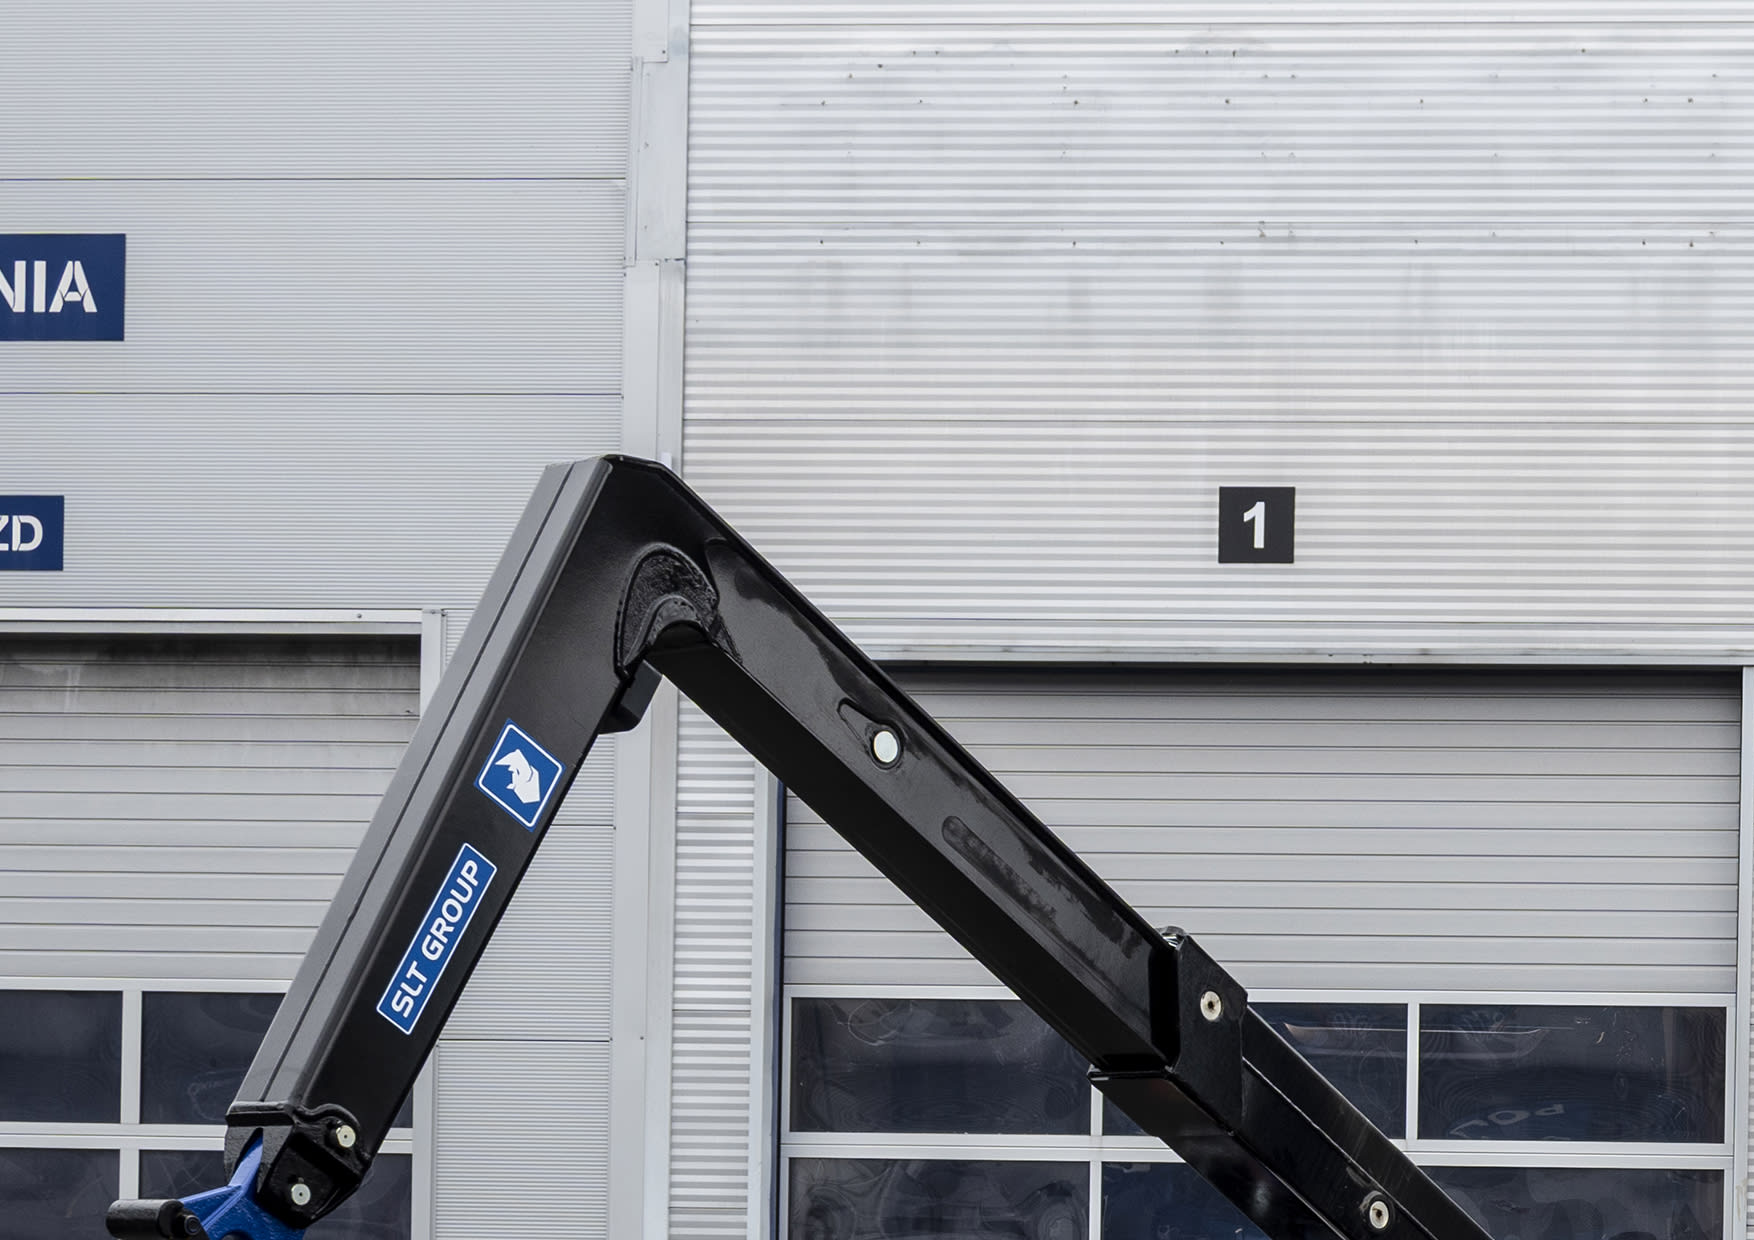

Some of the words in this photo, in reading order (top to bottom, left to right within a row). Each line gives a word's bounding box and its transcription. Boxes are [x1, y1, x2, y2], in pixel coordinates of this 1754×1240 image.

[1242, 501, 1265, 549] 1
[391, 960, 427, 1018] SLT
[421, 859, 480, 961] GROUP
